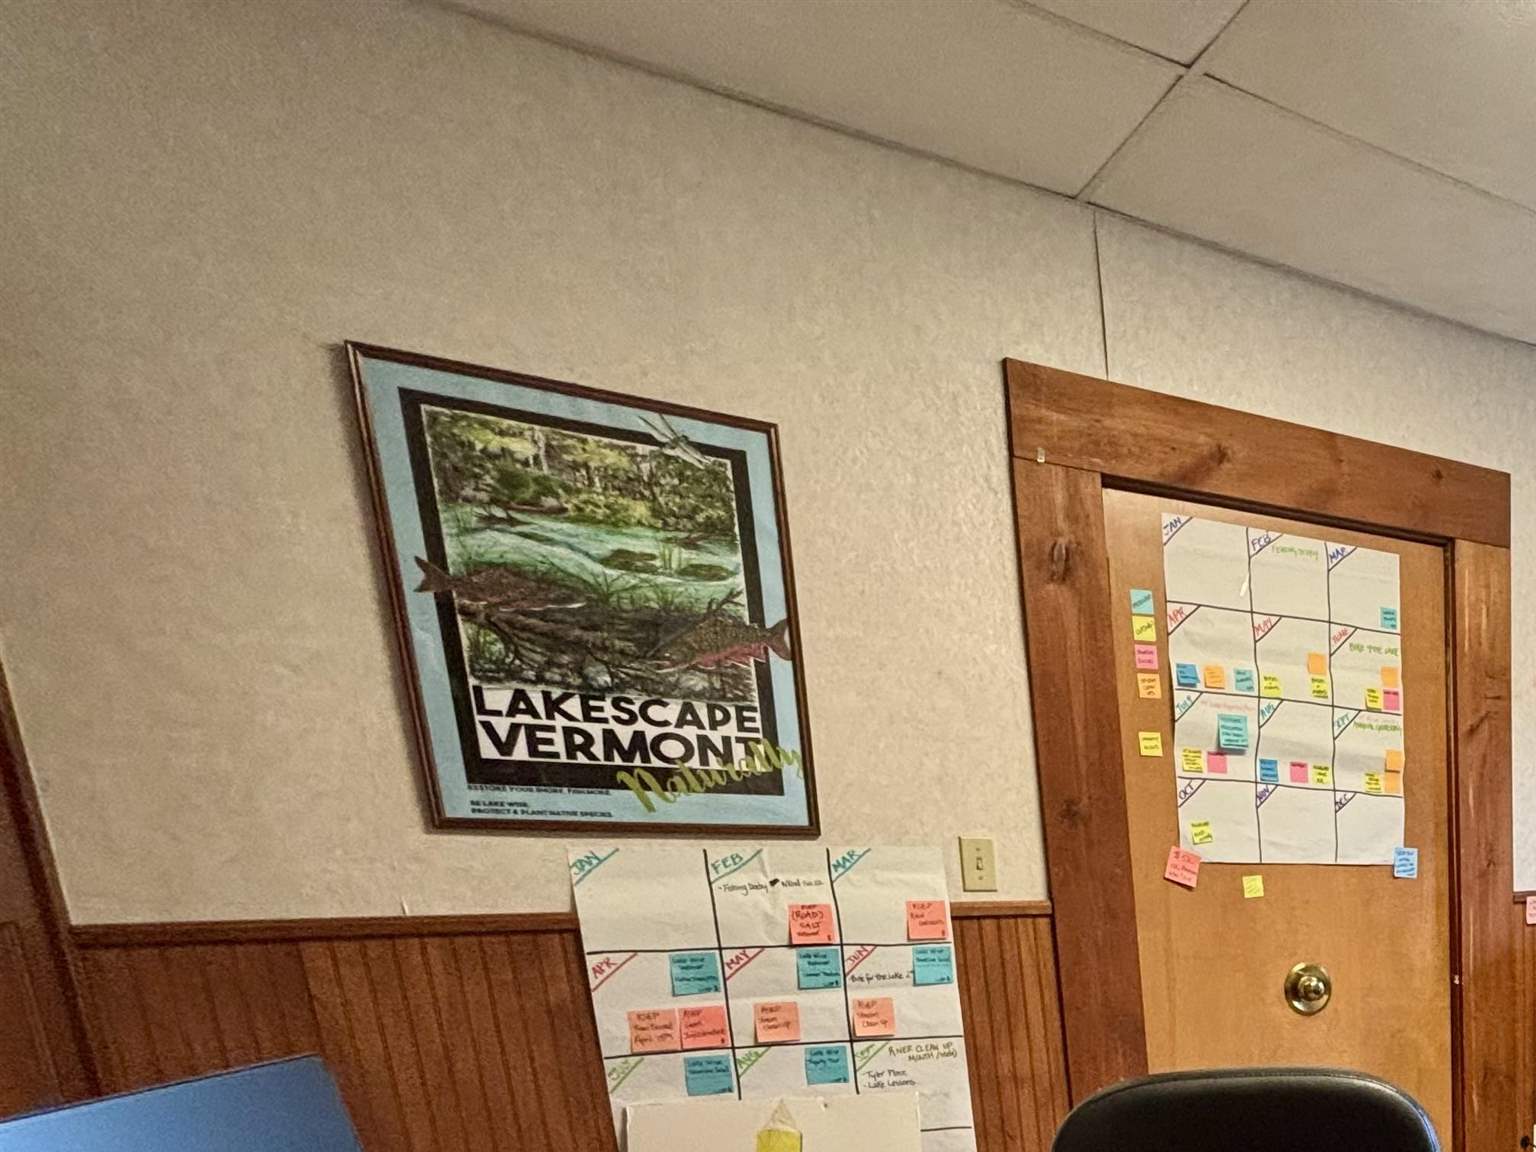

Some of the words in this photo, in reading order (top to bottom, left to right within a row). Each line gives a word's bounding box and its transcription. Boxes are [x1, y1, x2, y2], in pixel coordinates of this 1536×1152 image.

[1163, 517, 1182, 536] JAN
[1251, 534, 1272, 551] FEB
[472, 686, 760, 734] LAKESCAPE
[478, 721, 765, 771] VERMONT
[616, 739, 803, 813] Naturally
[508, 785, 534, 793] YOUR
[1178, 783, 1194, 801] OCT
[471, 807, 511, 815] PROTECT
[569, 851, 602, 876] JAN
[711, 853, 744, 875] FEB
[832, 850, 860, 872] MAR
[725, 950, 752, 971] MAY
[845, 946, 870, 965] JUN
[591, 957, 618, 979] APR
[915, 1043, 939, 1053] CLEAN
